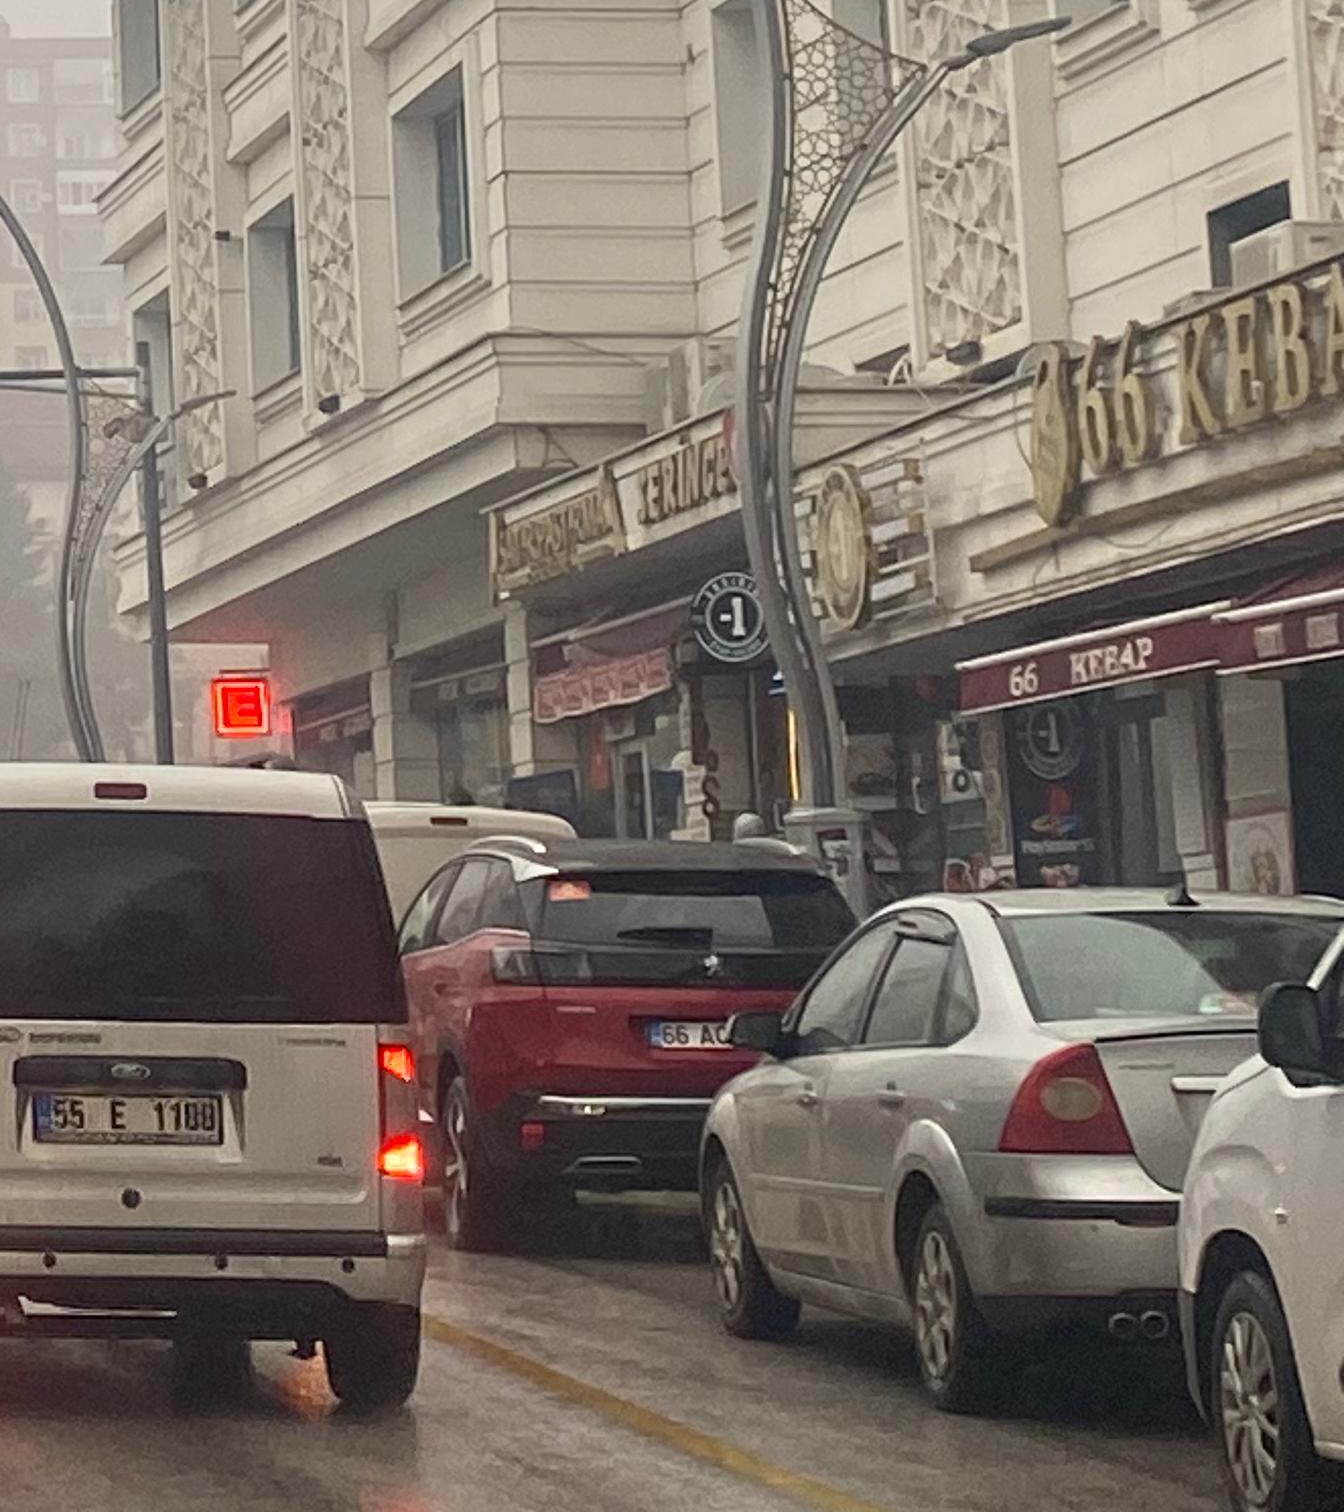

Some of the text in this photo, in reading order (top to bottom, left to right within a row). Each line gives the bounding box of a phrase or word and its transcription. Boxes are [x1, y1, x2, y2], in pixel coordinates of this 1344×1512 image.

[1077, 320, 1150, 476] 66
[1009, 638, 1154, 696] 66 KEBAP
[663, 1024, 689, 1044] 66
[54, 1099, 85, 1129] 55
[111, 1100, 126, 1129] E
